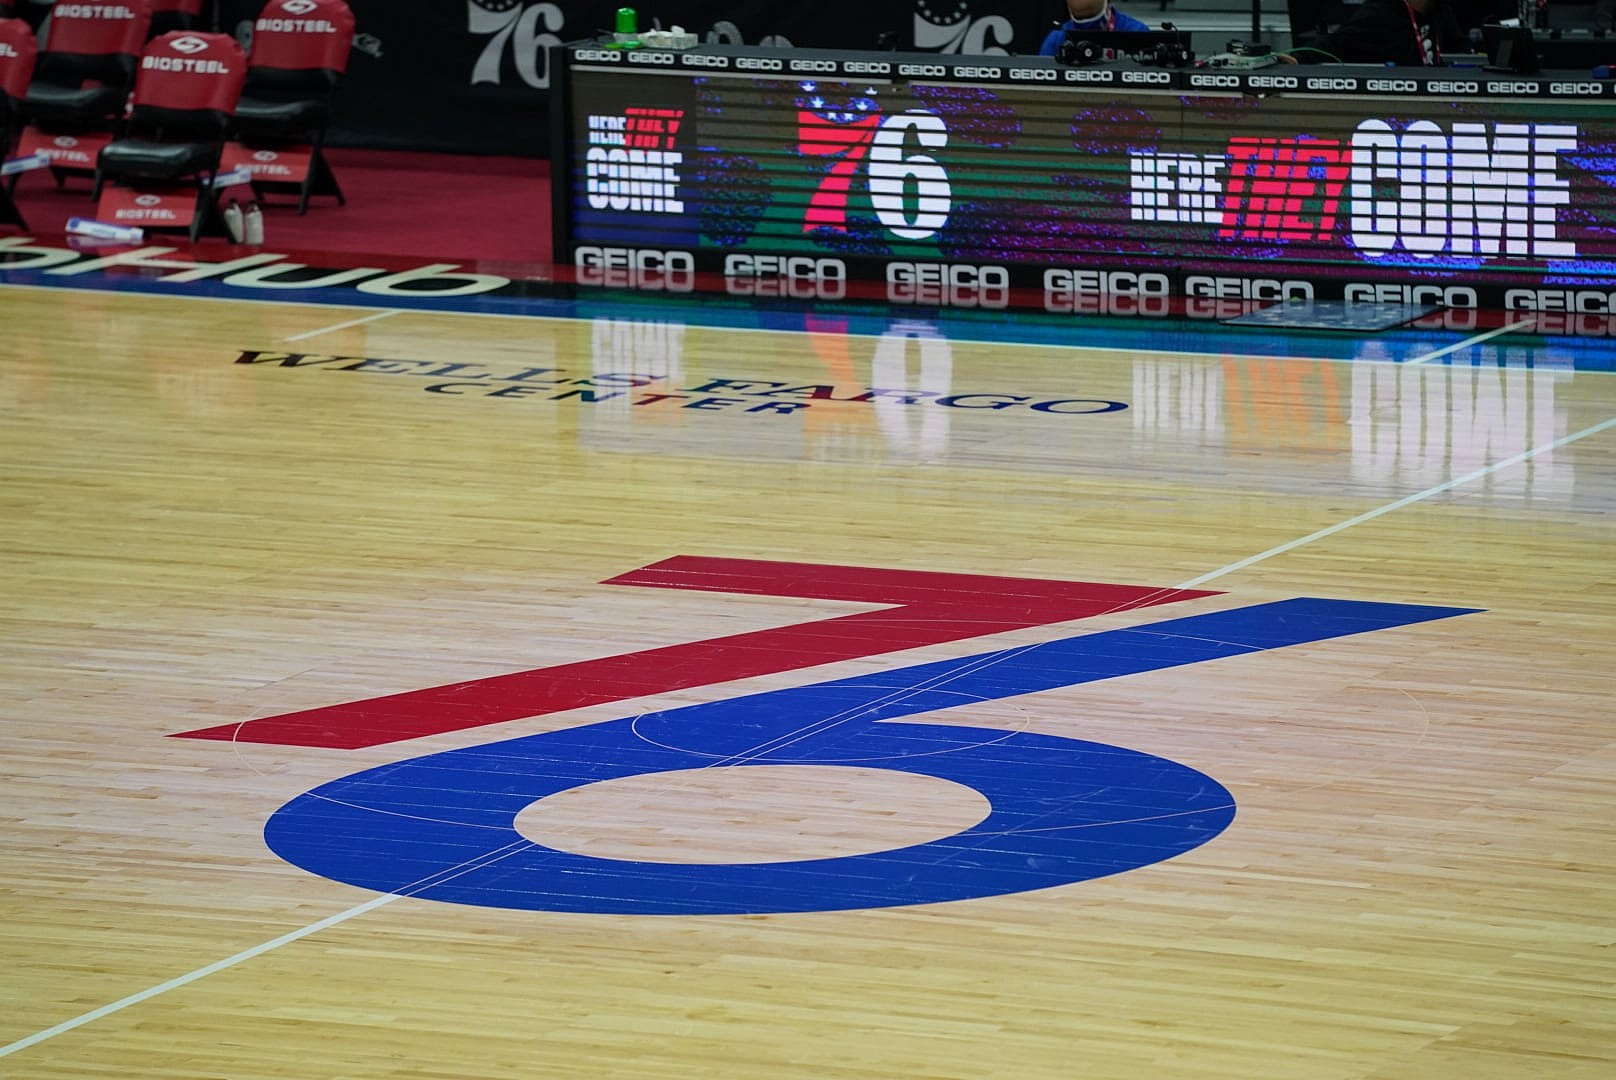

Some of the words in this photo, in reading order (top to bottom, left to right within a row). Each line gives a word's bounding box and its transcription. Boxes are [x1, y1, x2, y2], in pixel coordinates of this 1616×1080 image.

[55, 4, 136, 19] BIOSTEEL
[256, 19, 337, 33] BIOSTEEL
[142, 55, 230, 75] BIOSTEEL
[468, 0, 564, 89] 76
[574, 49, 621, 61] GEICO
[627, 51, 675, 65] GEICO
[681, 53, 729, 67] GEICO
[735, 57, 783, 70] GEICO
[789, 59, 838, 72] GEICO
[843, 61, 891, 74] GEICO
[898, 64, 946, 77] GEICO
[953, 66, 1001, 79] GEICO
[1009, 69, 1057, 81] GEICO
[1064, 70, 1113, 82] GEICO
[1121, 71, 1171, 83] GEICO
[1190, 75, 1240, 87] GEICO
[1248, 76, 1298, 88] GEICO
[1306, 78, 1357, 90] GEICO
[1366, 79, 1418, 92] GEICO
[1427, 81, 1479, 93] GEICO
[1487, 82, 1539, 94] GEICO
[1549, 83, 1603, 95] GEICO
[588, 115, 626, 145] HERE
[624, 107, 684, 149] THEY
[587, 148, 684, 213] COME
[797, 99, 951, 239] 76
[1130, 151, 1226, 224] HERE
[1219, 136, 1352, 241] THEY
[1351, 118, 1577, 258] COME
[115, 209, 176, 220] BIOSTEEL
[575, 246, 695, 273] GEICO
[886, 262, 1009, 289] GEICO
[1043, 269, 1170, 296] GEICO
[1185, 276, 1314, 301] GEICO
[1344, 284, 1477, 309] GEICO
[1505, 289, 1616, 315] GEIC
[233, 350, 667, 388] WELLS
[676, 377, 1129, 415] FARGO
[424, 382, 812, 415] CENTER
[167, 555, 1487, 916] 76
